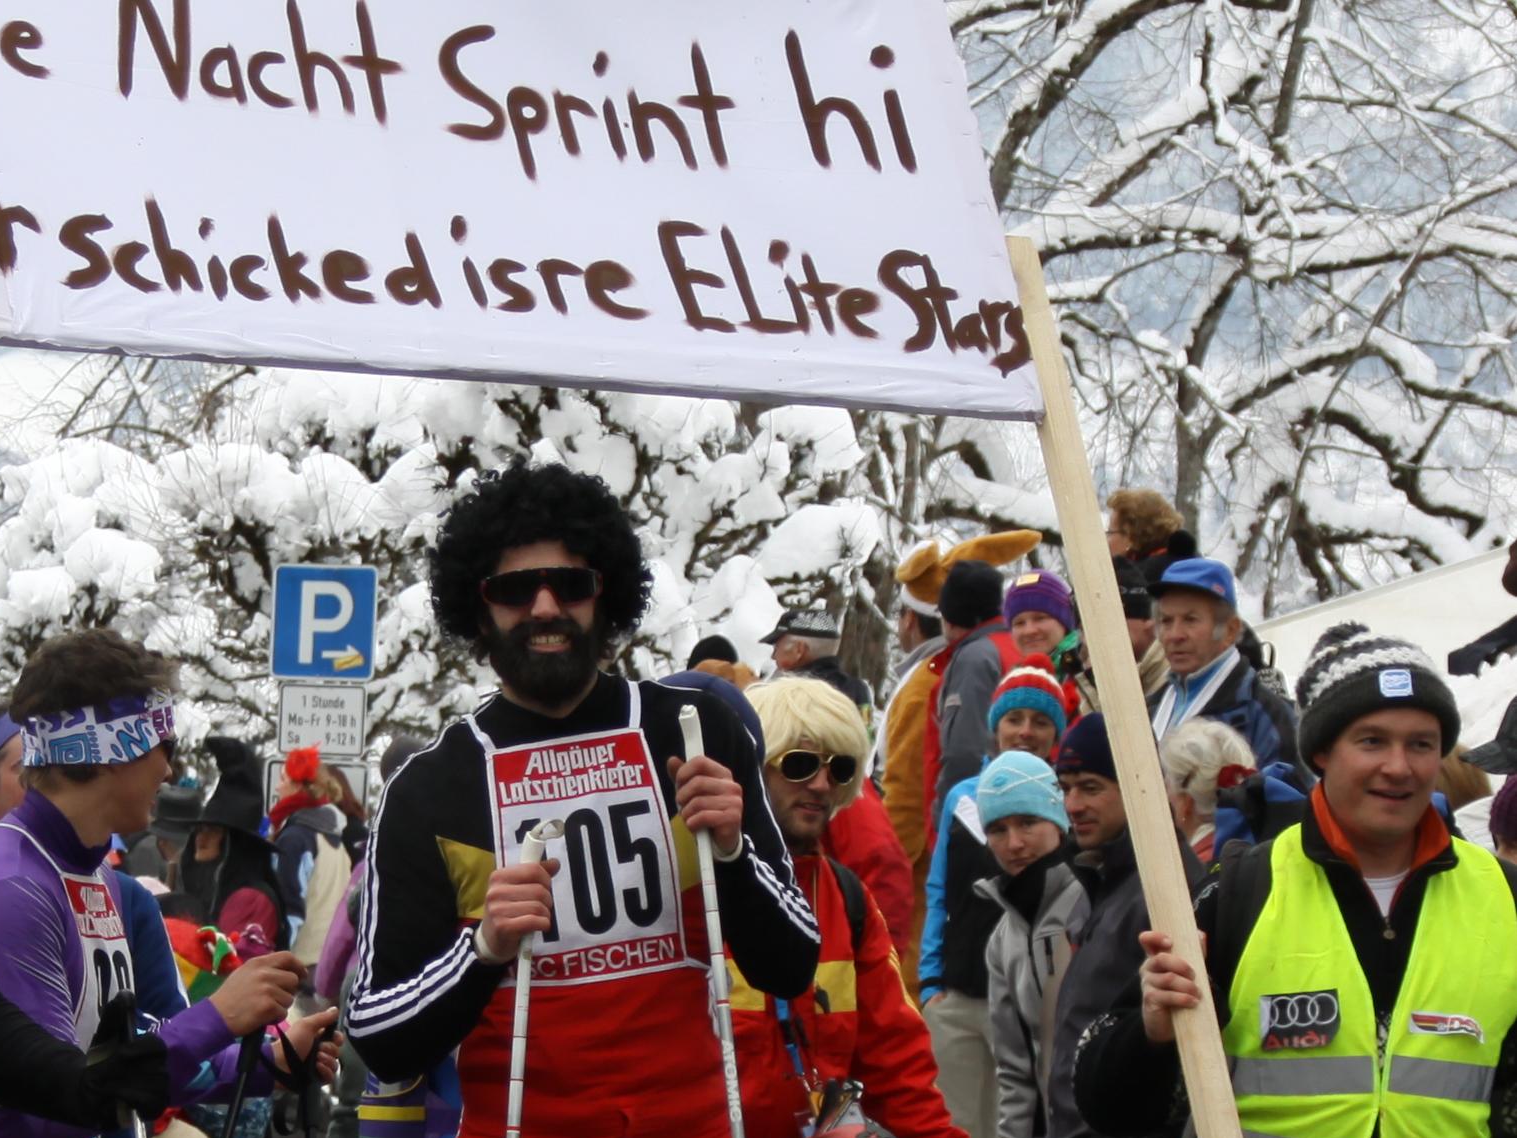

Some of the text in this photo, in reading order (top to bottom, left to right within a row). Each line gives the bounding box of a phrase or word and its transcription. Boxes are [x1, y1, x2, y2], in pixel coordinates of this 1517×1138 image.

[117, 0, 404, 126] Nacht
[438, 24, 736, 182] Sprint
[784, 28, 917, 174] hi
[298, 580, 354, 665] P
[311, 694, 346, 709] Stunde
[287, 730, 301, 744] Sa
[525, 742, 617, 776] Allgäuer
[499, 762, 645, 806] Latschenkiefer
[562, 938, 675, 976] FISCHEN
